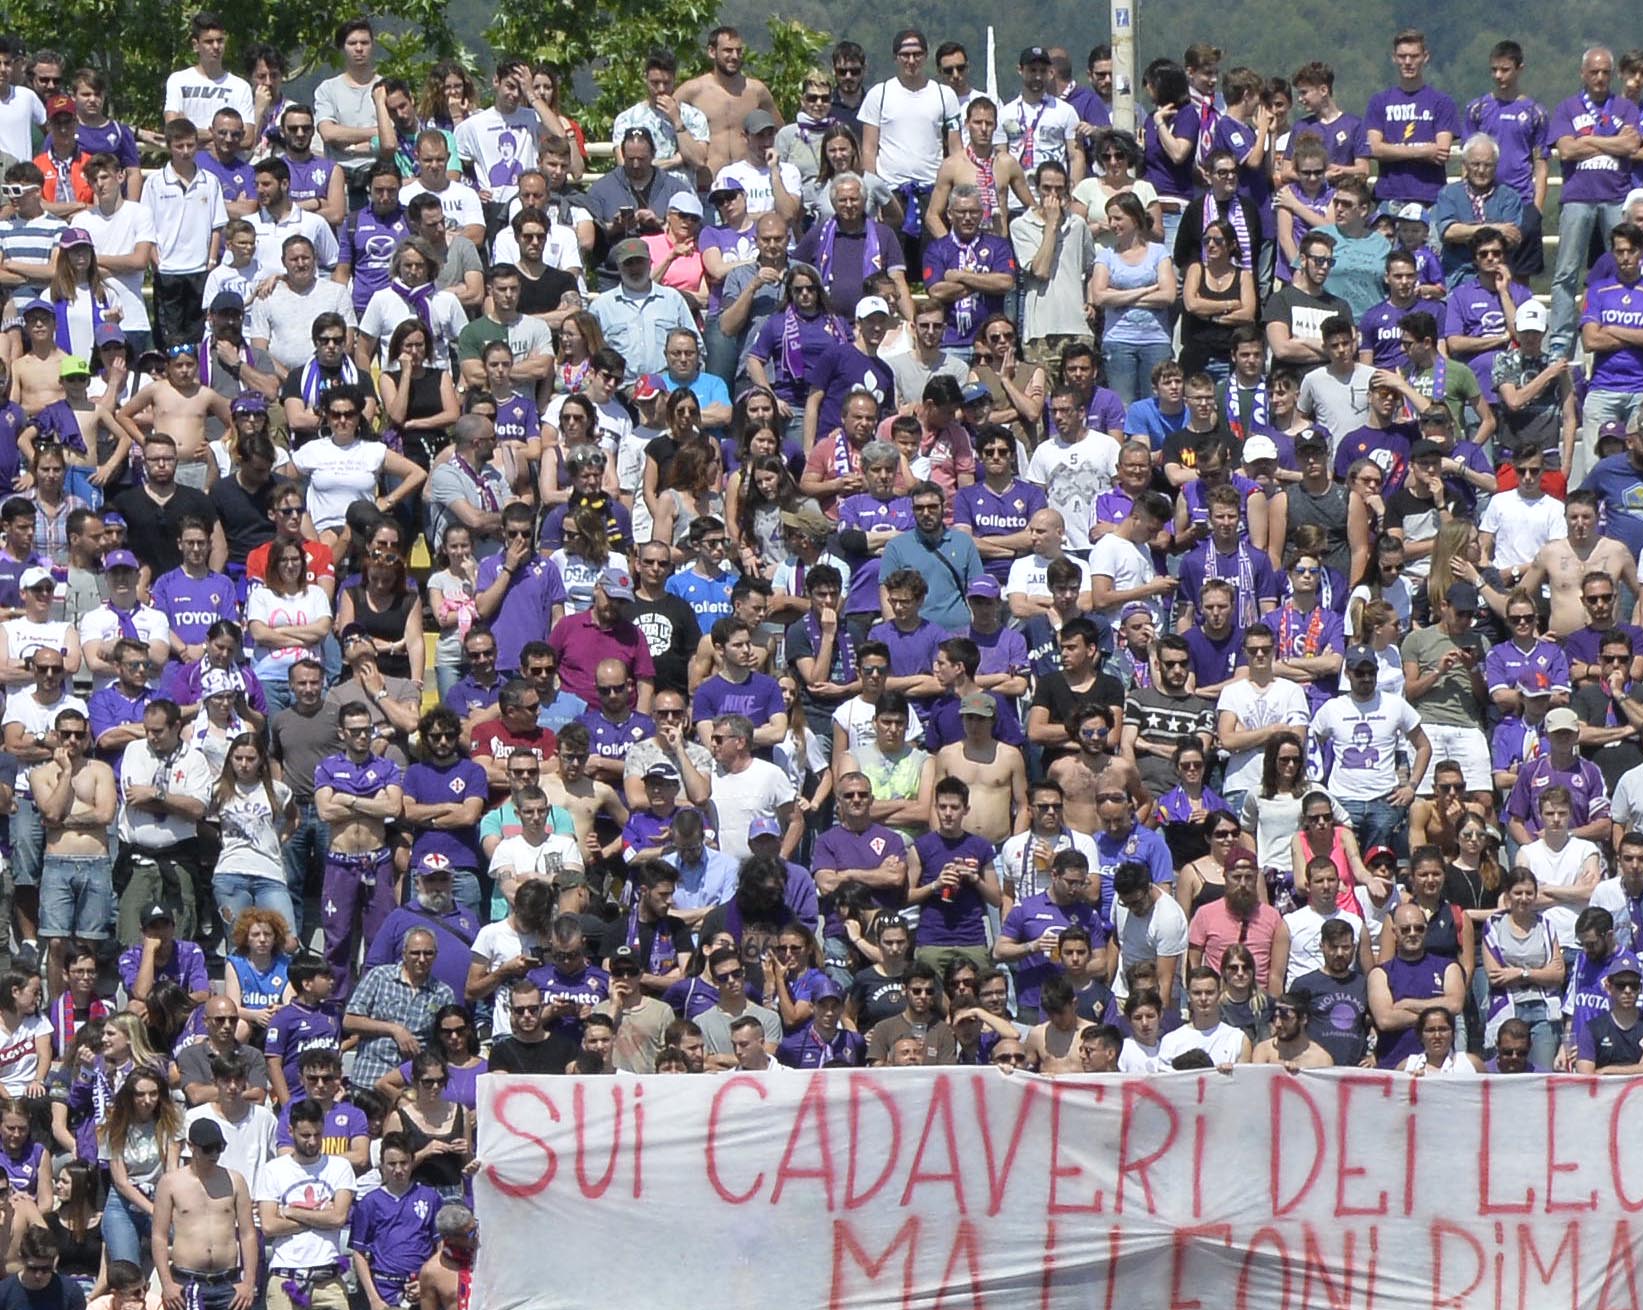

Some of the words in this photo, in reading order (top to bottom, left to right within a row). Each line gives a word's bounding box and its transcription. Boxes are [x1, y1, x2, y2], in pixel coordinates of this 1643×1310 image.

[975, 513, 1028, 531] folletto
[175, 612, 221, 626] TOYOT
[724, 695, 756, 711] NIKE
